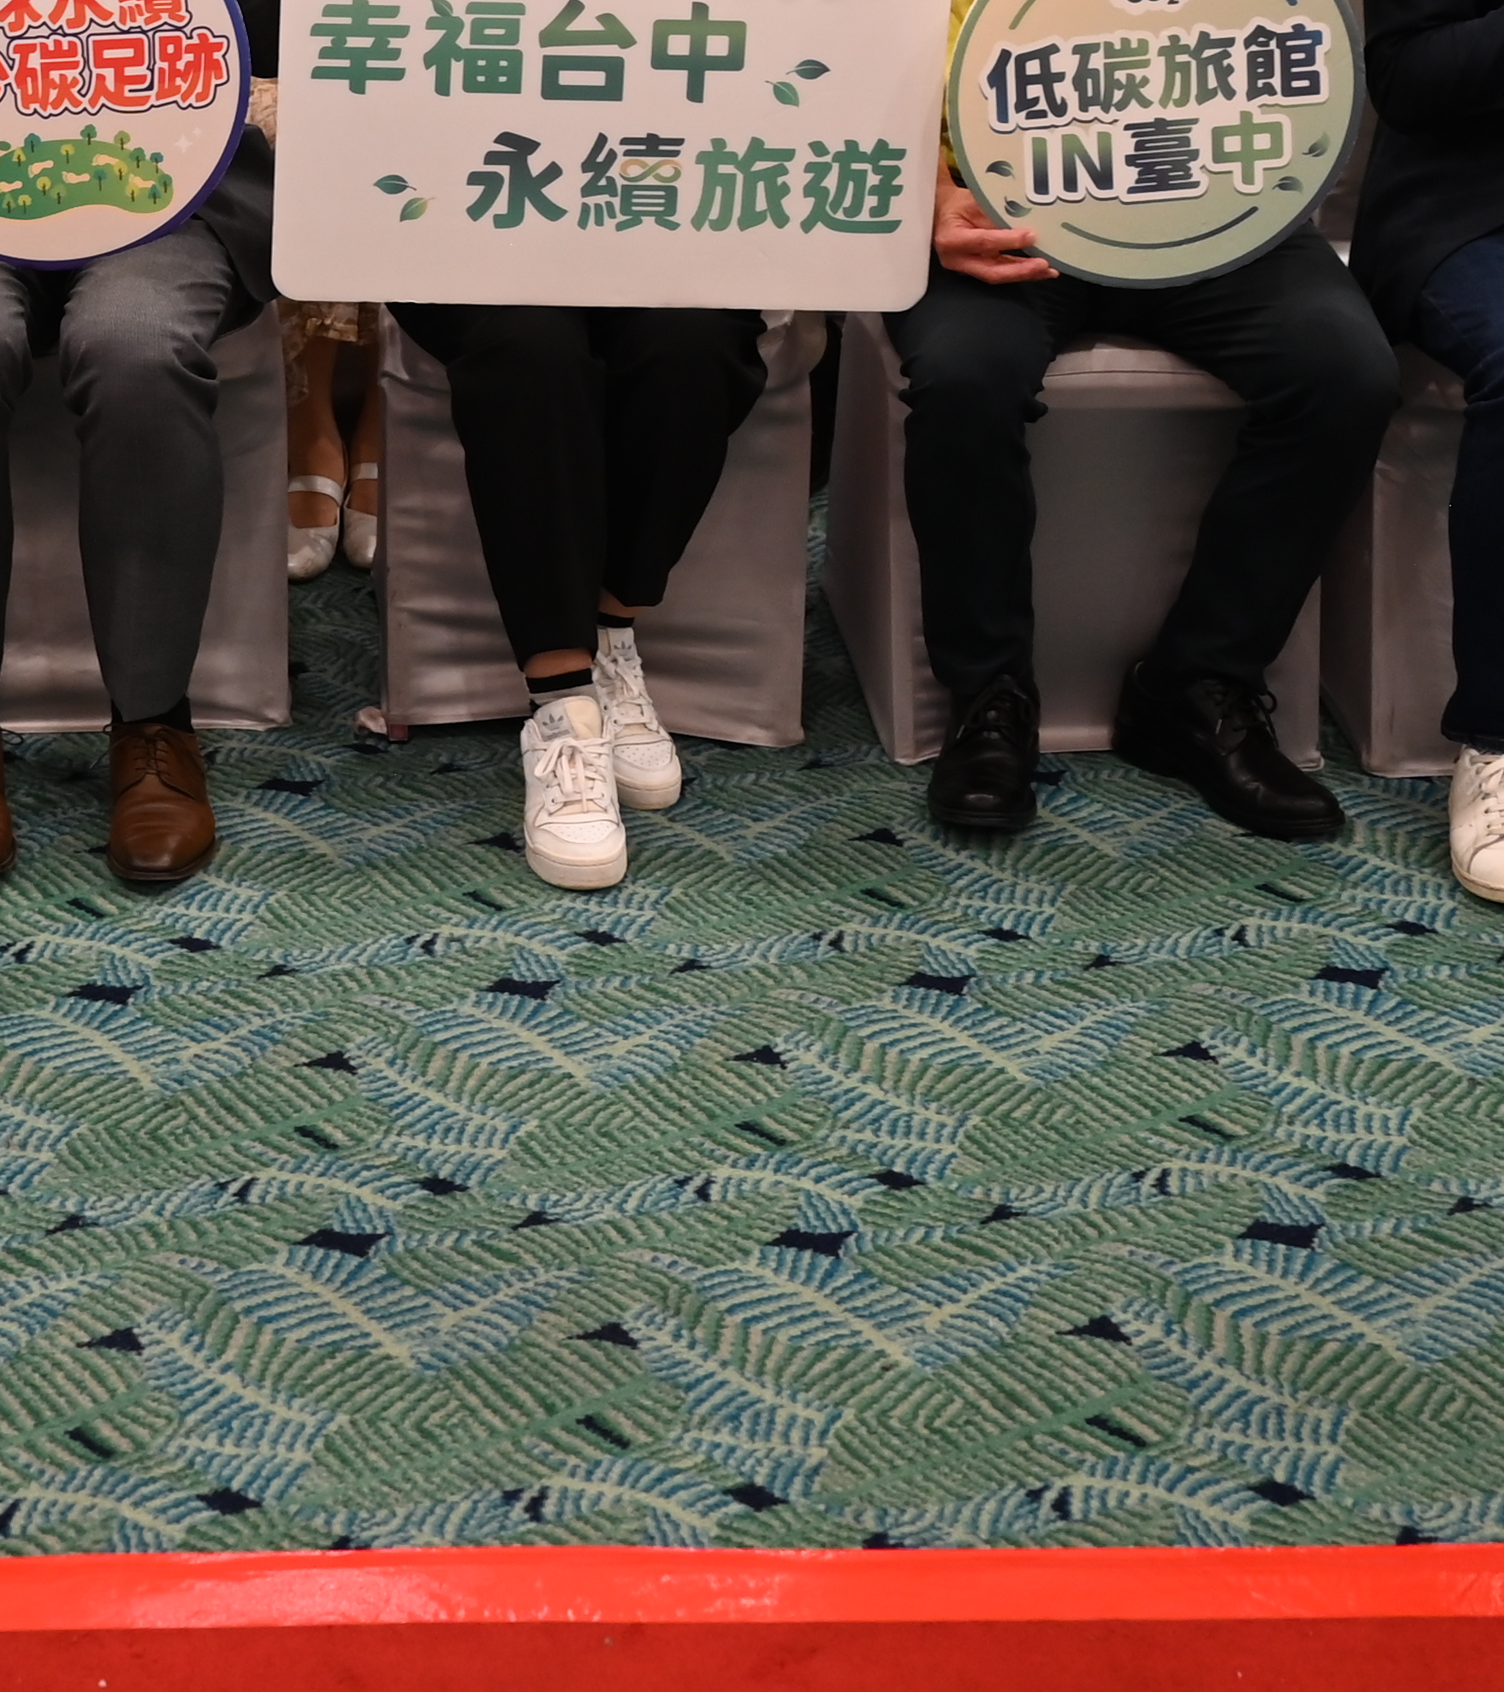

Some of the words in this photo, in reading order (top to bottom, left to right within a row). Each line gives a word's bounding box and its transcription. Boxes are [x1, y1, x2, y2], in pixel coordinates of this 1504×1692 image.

[986, 21, 1325, 125] 低碳旅館
[464, 130, 908, 235] 永續旅遊
